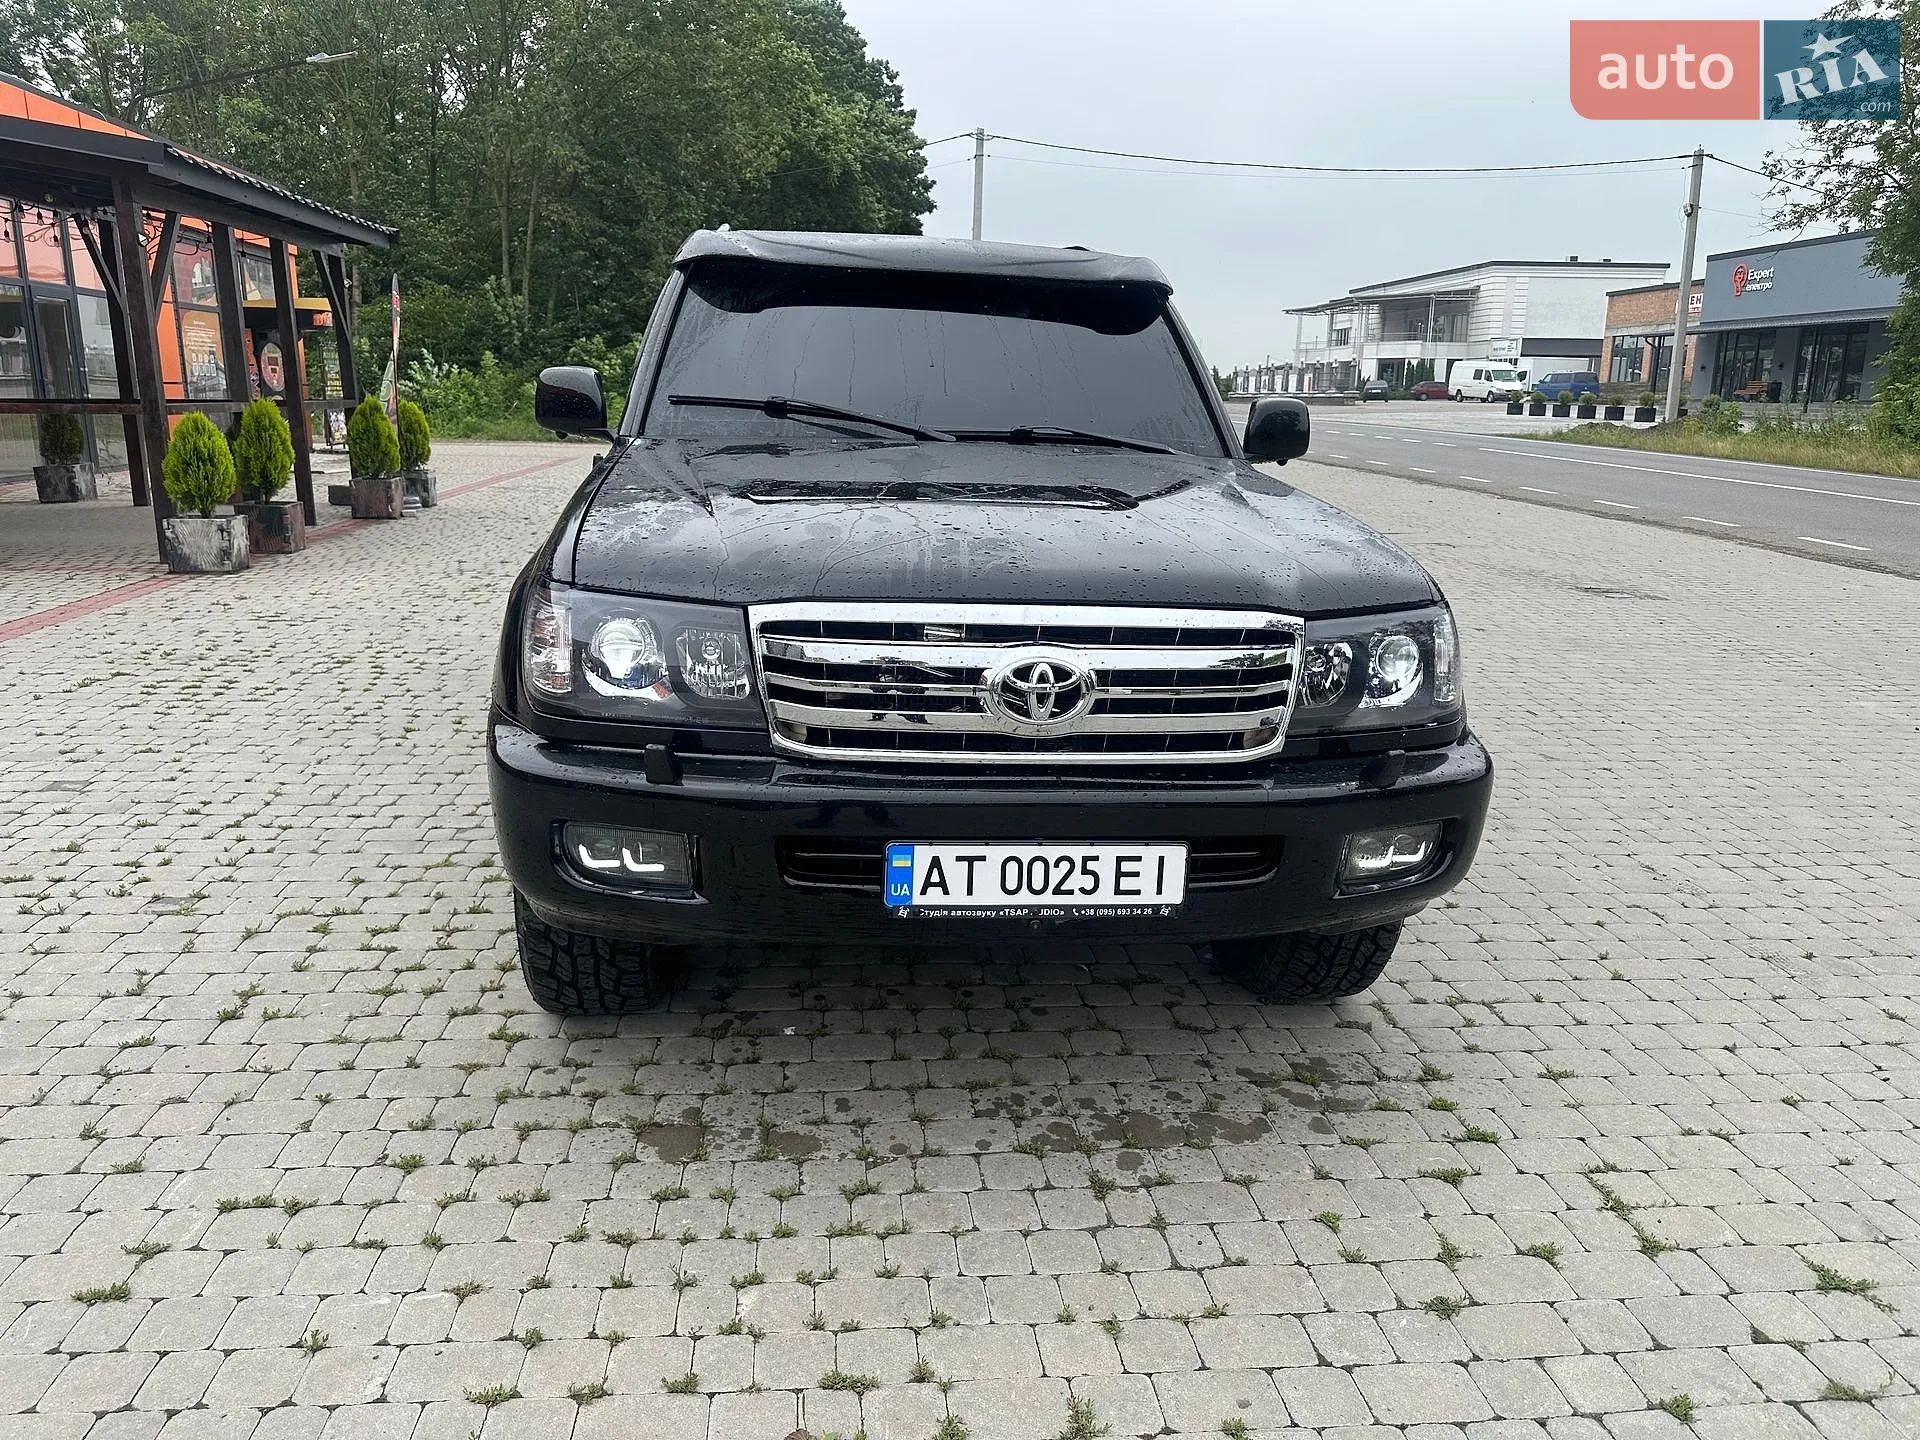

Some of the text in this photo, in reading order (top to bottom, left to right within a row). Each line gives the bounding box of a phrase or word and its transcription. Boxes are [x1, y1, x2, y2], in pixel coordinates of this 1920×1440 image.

[1748, 266, 1774, 281] Expert
[920, 855, 1165, 896] AT 0025 EI
[891, 884, 910, 896] UA
[951, 909, 996, 918] автозвуку
[1096, 908, 1115, 917] (095)
